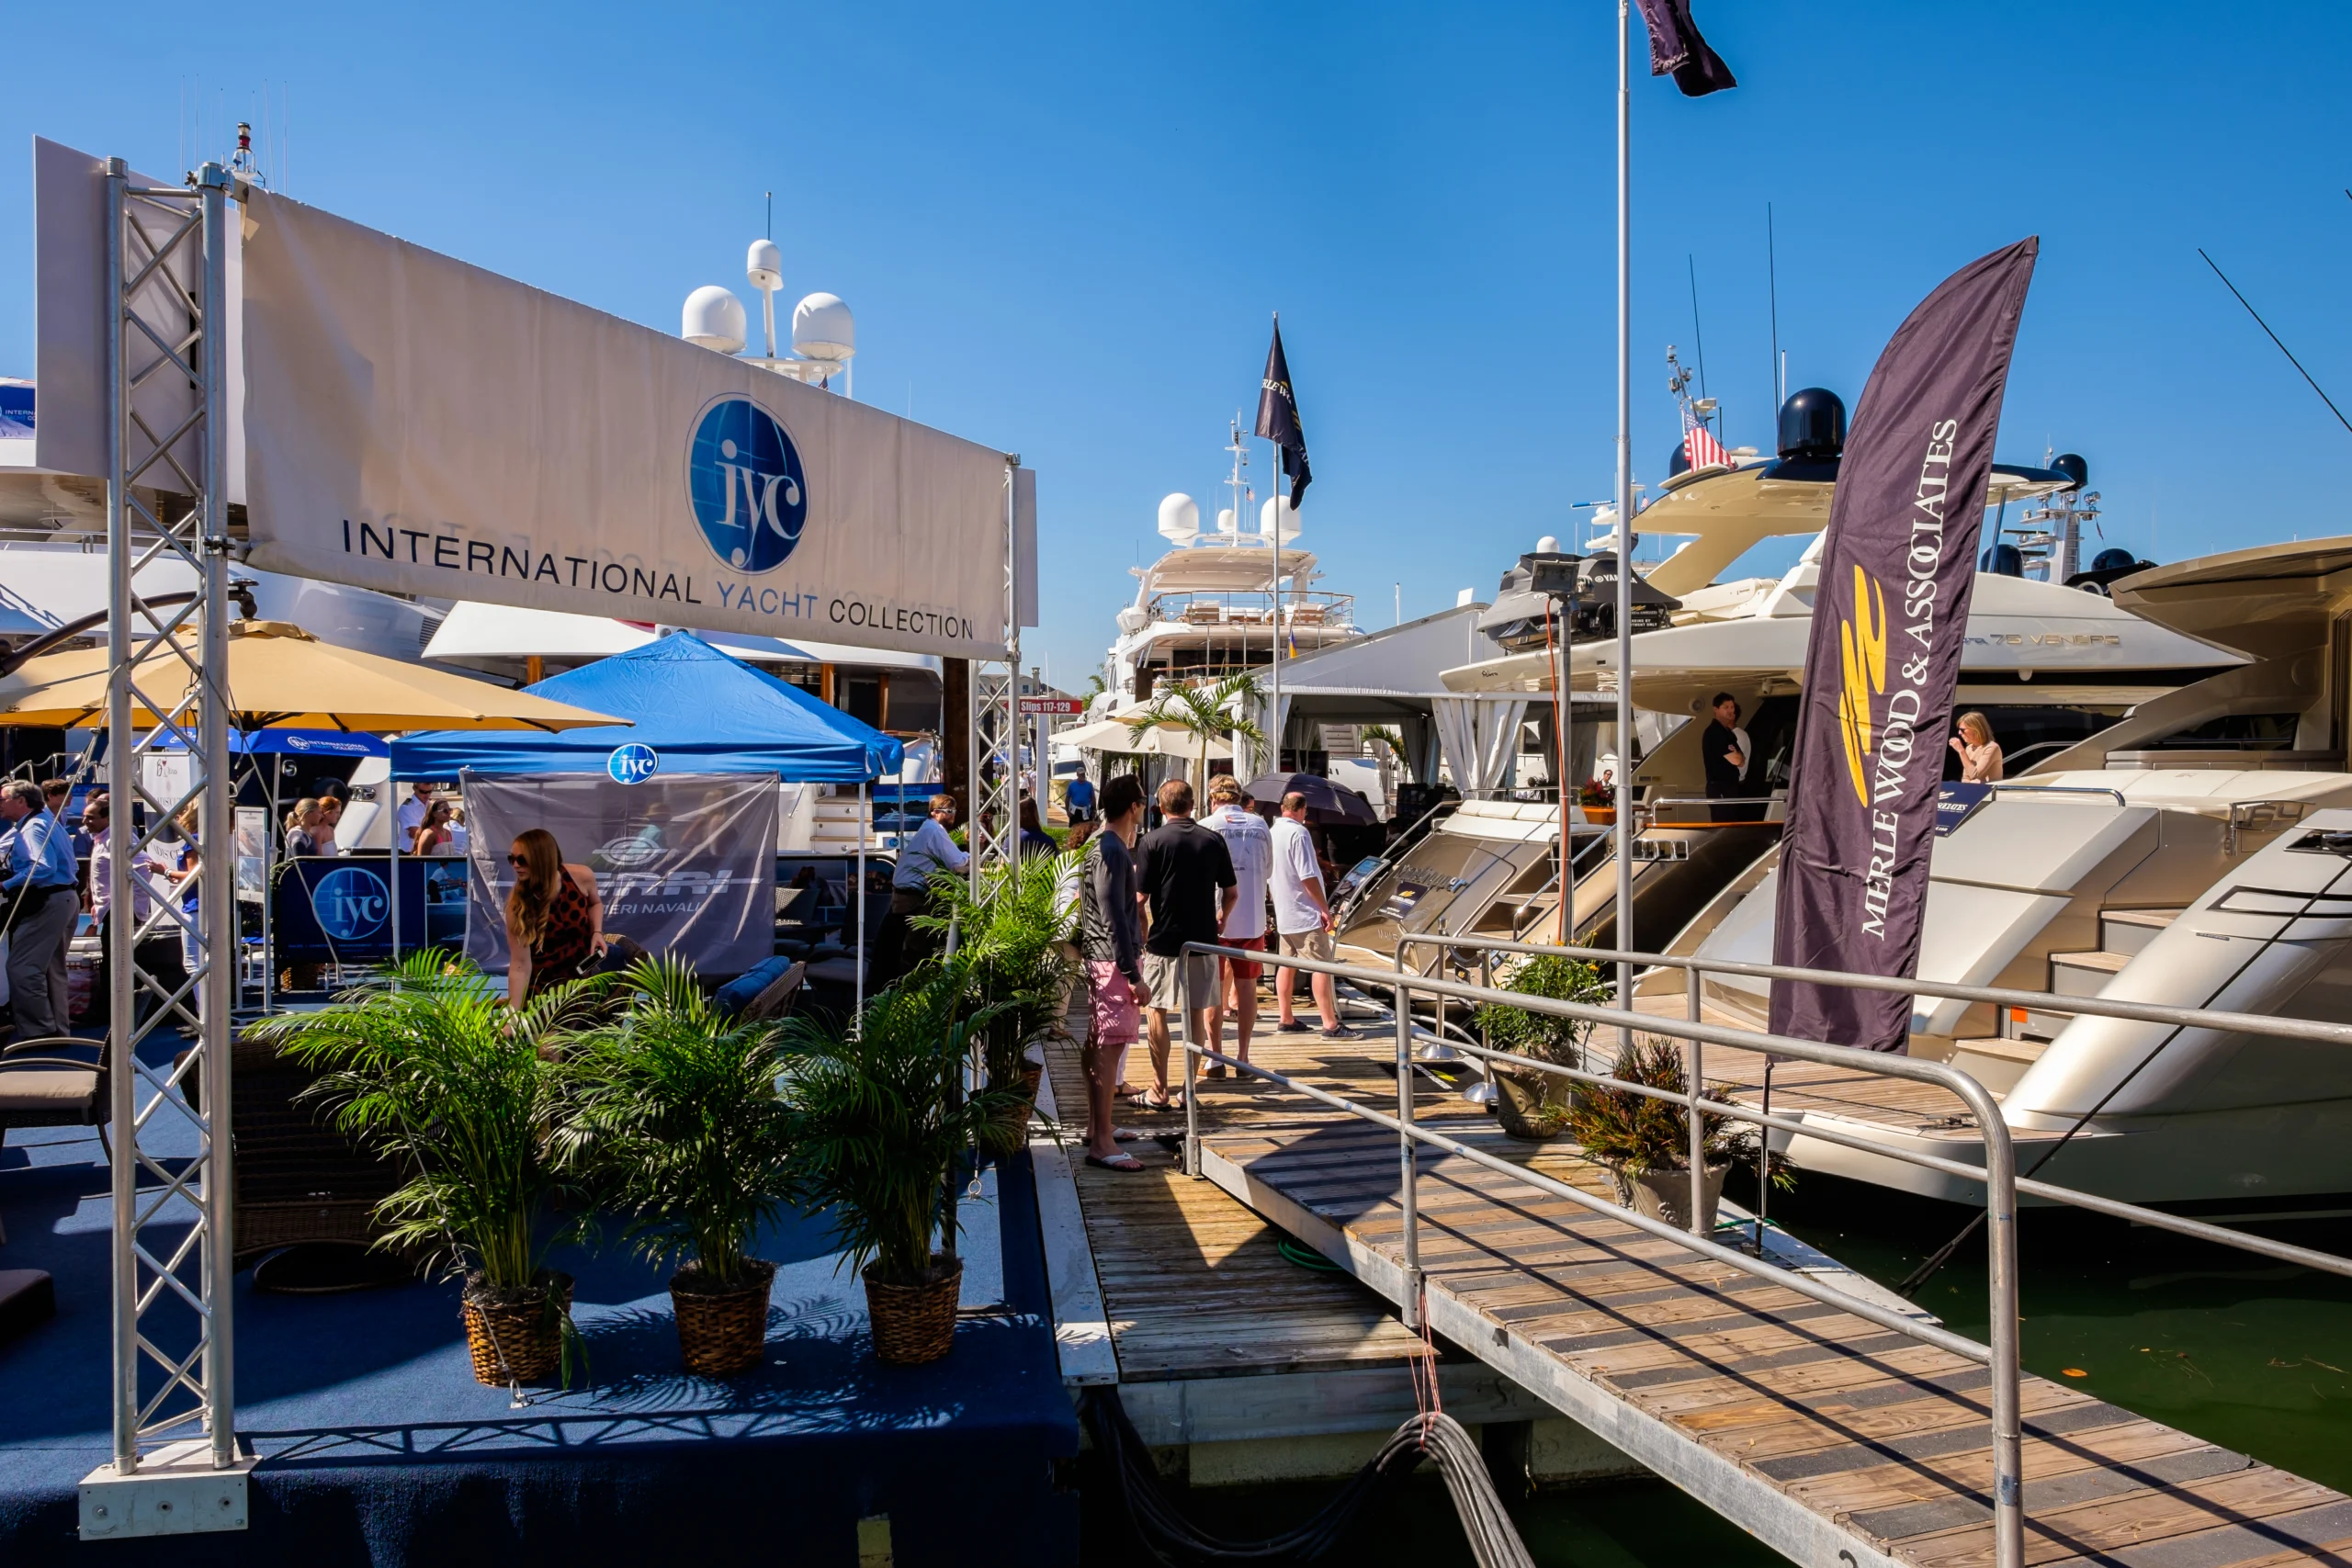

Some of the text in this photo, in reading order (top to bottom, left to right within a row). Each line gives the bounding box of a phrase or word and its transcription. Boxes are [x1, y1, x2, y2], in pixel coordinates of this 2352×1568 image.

[343, 518, 974, 640] INTERNATIONAL YACHT COLLECTION
[1862, 419, 1958, 942] MERLE WOOD & ASSOCIATES
[1021, 701, 1070, 712] Slips 117-129
[618, 754, 653, 784] iyc
[331, 887, 384, 937] iyc
